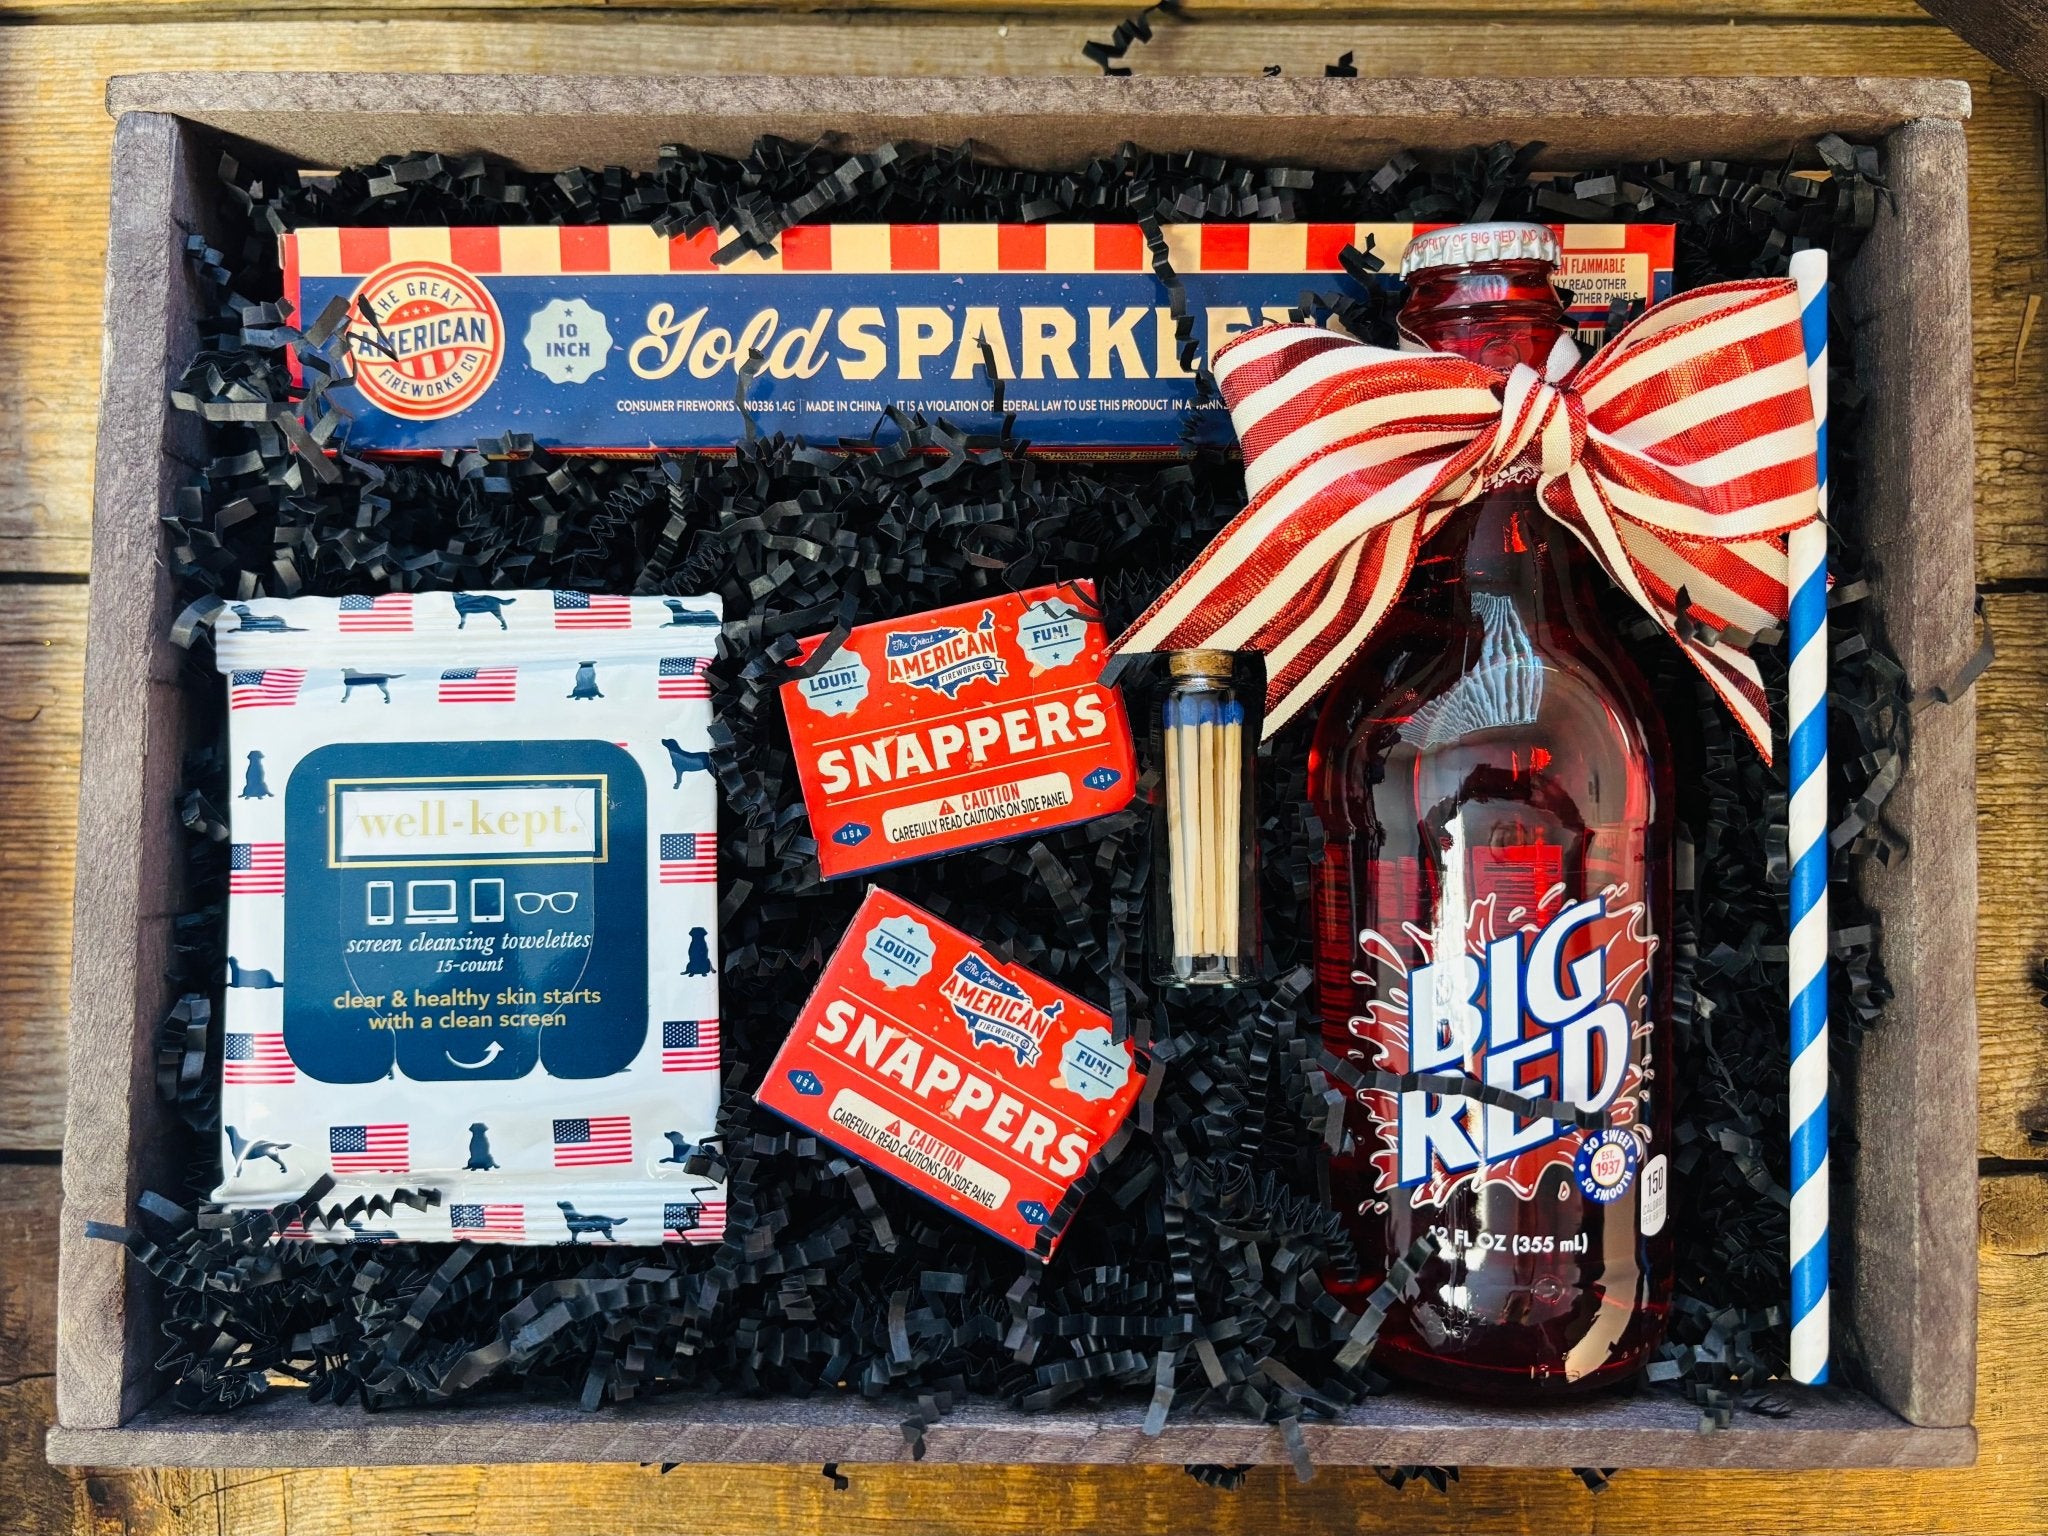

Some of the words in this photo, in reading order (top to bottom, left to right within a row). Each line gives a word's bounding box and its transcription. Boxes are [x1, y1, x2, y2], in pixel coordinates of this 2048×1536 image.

[1452, 233, 1467, 248] OF
[1471, 231, 1490, 245] BIG
[1571, 257, 1626, 274] FLAMMABLE
[406, 281, 462, 307] GREAT
[1569, 279, 1594, 291] READ
[1595, 278, 1627, 290] OTHER
[1573, 292, 1603, 304] OTHER
[358, 316, 487, 359] AMERICAN
[558, 323, 578, 339] 10
[629, 302, 834, 380] Gold
[545, 342, 592, 359] INCH
[378, 368, 463, 397] FIREWORKS
[460, 353, 478, 372] CO
[616, 400, 675, 412] CONSUMER
[676, 400, 735, 412] FIREWORKS
[776, 400, 796, 412] 1.4G
[806, 400, 835, 412] MADE
[837, 400, 848, 412] IN
[849, 400, 882, 412] CHINA
[896, 400, 905, 412] IT
[907, 400, 916, 412] IS
[917, 400, 925, 412] A
[926, 400, 979, 412] VIOLATION
[980, 400, 994, 412] OF
[1002, 399, 1040, 412] EDERAL
[1041, 399, 1062, 411] LAW
[1064, 399, 1076, 411] TO
[1078, 399, 1097, 411] USE
[1098, 399, 1120, 411] THIS
[1121, 399, 1168, 411] PRODUCT
[1172, 399, 1182, 410] IN
[1184, 399, 1192, 410] A
[892, 638, 909, 651] The
[909, 635, 934, 651] Great
[1032, 625, 1069, 644] FUN!
[890, 631, 996, 681] AMERICAN
[808, 670, 858, 692] LOUD!
[941, 662, 981, 684] FIREWORKS
[817, 692, 1107, 795] SNAPPERS
[1092, 771, 1114, 786] USA
[961, 783, 1021, 812] CAUTION
[359, 799, 580, 847] well-kept.
[892, 817, 939, 843] CAREFULLY
[939, 813, 963, 831] READ
[963, 803, 1007, 827] CAUTIONS
[1007, 800, 1022, 817] ON
[1022, 796, 1041, 813] SIDE
[1041, 790, 1069, 810] PANEL
[841, 828, 863, 841] USA
[346, 937, 403, 953] screen
[409, 931, 496, 955] cleansing
[501, 929, 592, 951] towelettes
[874, 934, 922, 969] LOUD!
[436, 956, 504, 974] 15-count
[964, 960, 979, 977] The
[980, 971, 1004, 990] Great
[1408, 895, 1606, 1076] BIG
[333, 990, 384, 1009] clear
[391, 990, 408, 1008] &
[414, 989, 490, 1012] healthy
[496, 988, 537, 1006] skin
[542, 988, 601, 1005] starts
[941, 974, 1050, 1040] AMERICAN
[368, 1011, 415, 1031] with
[420, 1015, 433, 1029] a
[438, 1011, 493, 1029] clean
[499, 1012, 566, 1027] screen
[978, 1021, 1021, 1043] FIREWORKS
[1076, 1048, 1113, 1079] FUN!
[795, 1073, 815, 1093] USA
[815, 999, 1088, 1179] SNAPPERS
[1398, 999, 1631, 1188] RED
[907, 1129, 966, 1172] CAUTION
[1583, 1137, 1600, 1155] SO
[1602, 1129, 1633, 1151] SWEET
[832, 1107, 880, 1142] CAREFULLY
[875, 1131, 901, 1155] READ
[898, 1144, 941, 1178] CAUTIONS
[937, 1166, 954, 1185] ON
[951, 1172, 972, 1195] SIDE
[970, 1185, 998, 1210] PANEL
[1595, 1158, 1621, 1177] 1937
[1601, 1150, 1615, 1160] EST.
[1581, 1177, 1596, 1194] SO
[1593, 1169, 1633, 1201] SMOOTH
[1646, 1166, 1664, 1197] 150
[1025, 1205, 1044, 1222] USA
[1454, 1228, 1473, 1247] FL
[1476, 1231, 1507, 1251] OZ
[1512, 1234, 1555, 1256] (355
[1559, 1233, 1588, 1254] mL)
